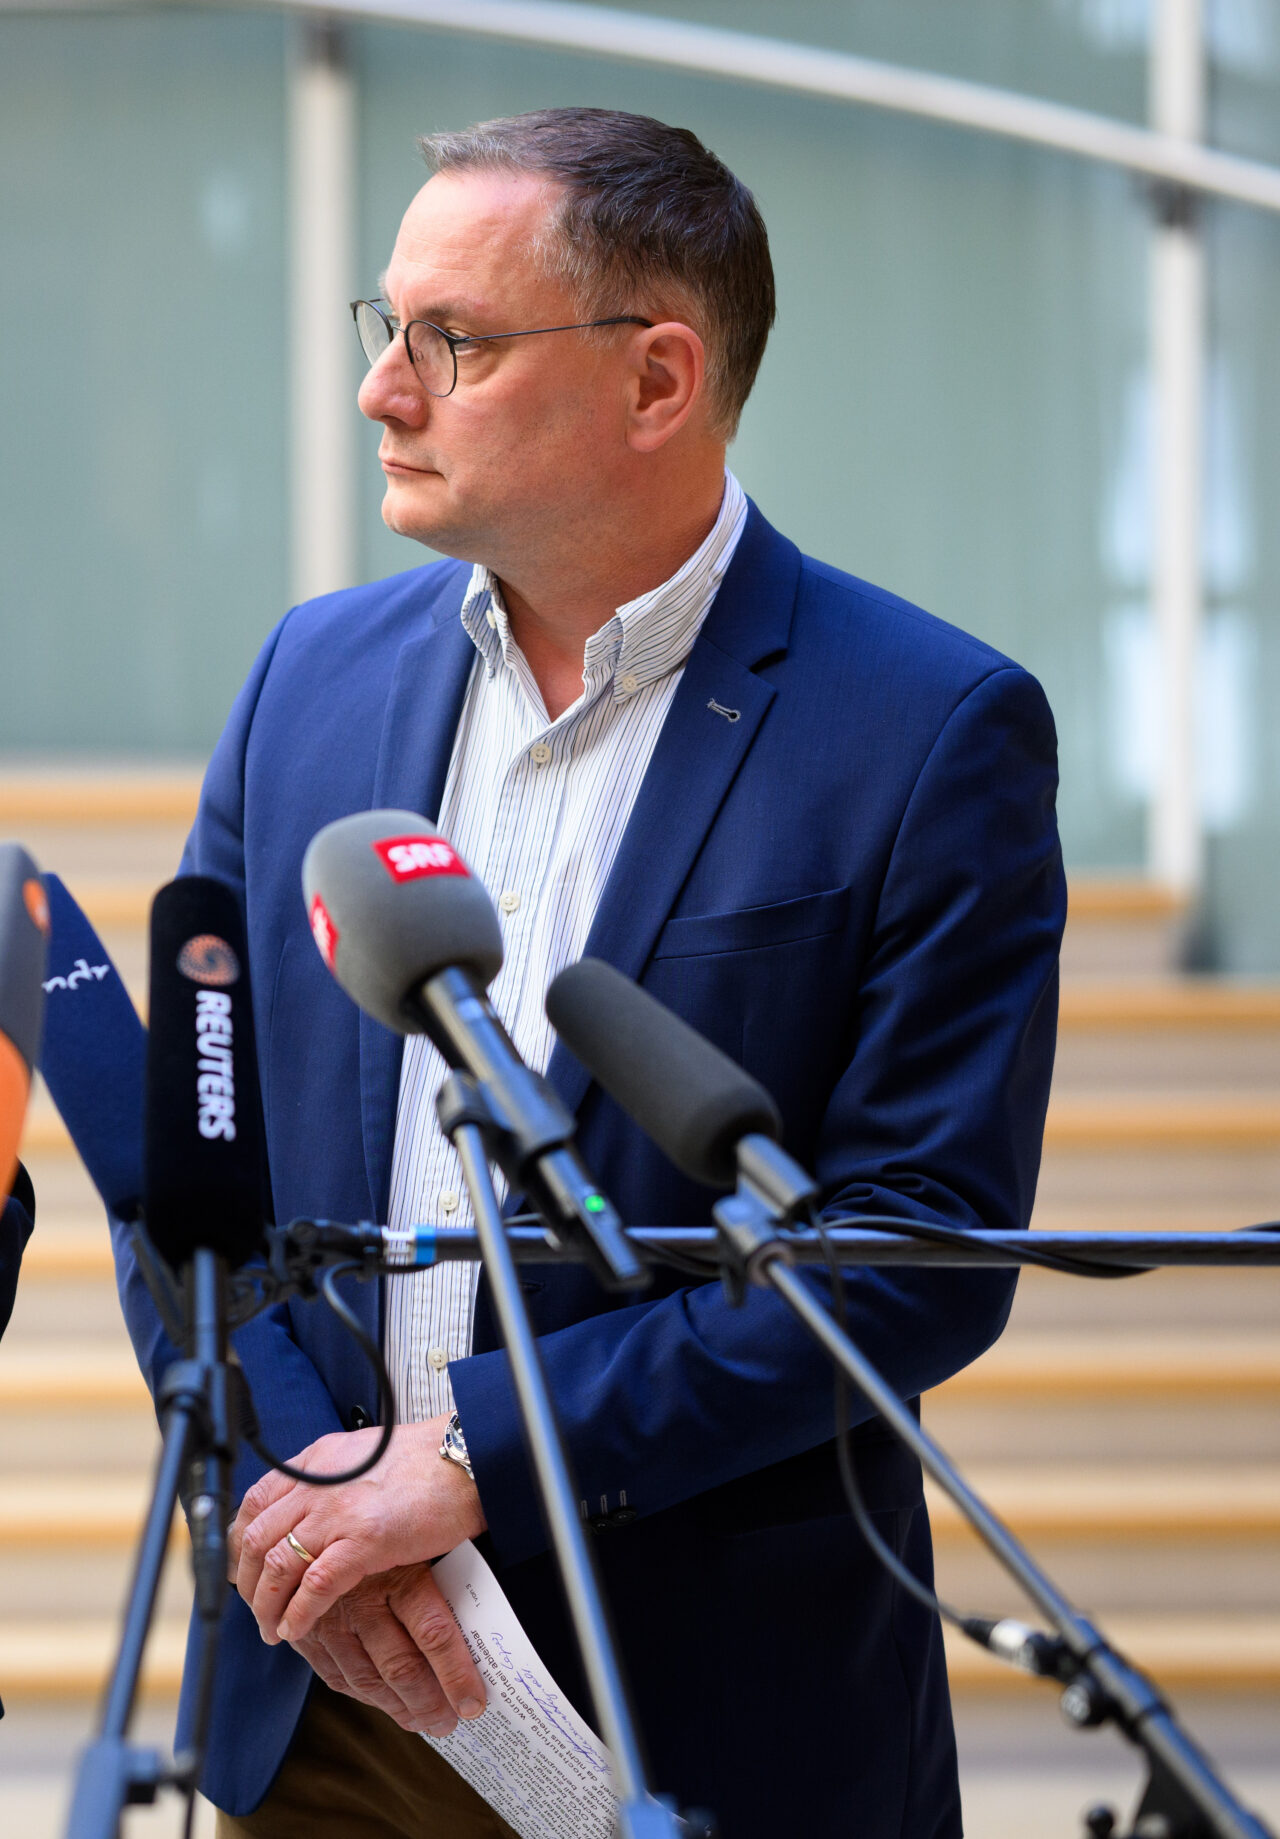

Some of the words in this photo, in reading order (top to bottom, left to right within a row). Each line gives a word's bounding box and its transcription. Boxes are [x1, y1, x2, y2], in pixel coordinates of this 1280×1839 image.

[387, 843, 454, 872] SRF
[196, 990, 236, 1142] REUTERS
[469, 1588, 478, 1601] von
[470, 1628, 498, 1670] ableitbar
[481, 1668, 498, 1687] mit
[495, 1669, 516, 1695] Urteil
[499, 1690, 527, 1720] würde
[495, 1709, 511, 1725] das
[514, 1695, 550, 1735] heutigem
[477, 1715, 520, 1759] Verbotsver
[502, 1731, 518, 1747] gibt
[516, 1729, 530, 1743] hat
[549, 1734, 566, 1750] aus
[456, 1739, 490, 1775] nächsten
[519, 1749, 530, 1760] es
[529, 1724, 585, 1780] Hochstufung
[565, 1749, 586, 1770] nicht
[443, 1743, 490, 1792] Deutschland
[501, 1762, 513, 1776] mit
[506, 1760, 523, 1779] eine
[521, 1759, 545, 1784] einem
[531, 1754, 552, 1774] einer
[490, 1775, 505, 1792] den
[513, 1777, 526, 1791] nur
[552, 1775, 563, 1785] zu
[586, 1770, 598, 1782] da
[469, 1761, 519, 1815] Implikationen
[505, 1793, 513, 1801] in
[523, 1779, 542, 1799] lässt
[545, 1784, 556, 1795] zu
[527, 1792, 543, 1808] sich
[556, 1796, 581, 1822] Schritt
[581, 1794, 597, 1810] das
[525, 1798, 564, 1839] enfassung
[541, 1798, 581, 1839] rdachtsfall
[543, 1809, 557, 1823] hat
[550, 1798, 581, 1830] müssen
[563, 1786, 614, 1836] Verdachtsfall
[567, 1800, 589, 1821] OVG
[530, 1819, 541, 1831] wir
[557, 1823, 571, 1838] icht
[591, 1822, 607, 1839] Das
